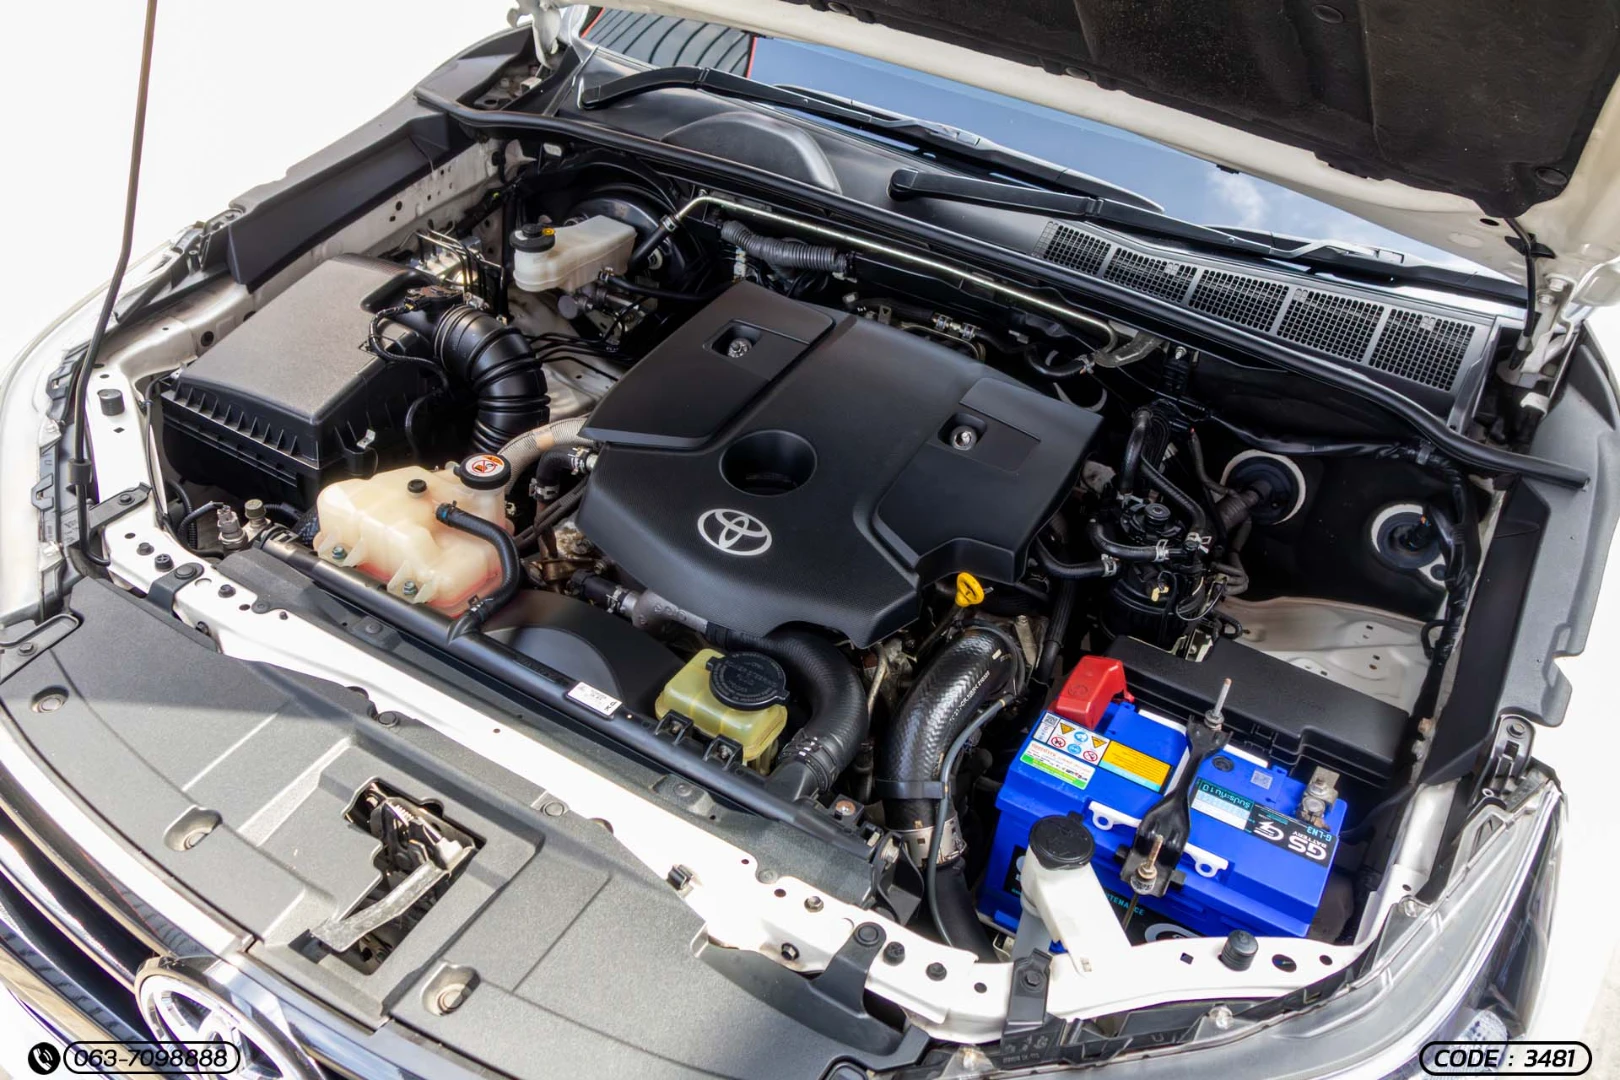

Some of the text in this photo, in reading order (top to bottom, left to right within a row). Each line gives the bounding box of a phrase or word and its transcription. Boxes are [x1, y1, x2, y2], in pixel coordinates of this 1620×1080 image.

[1292, 830, 1328, 849] BATTERY
[1306, 825, 1333, 842] G-LN3
[1287, 835, 1327, 861] GS
